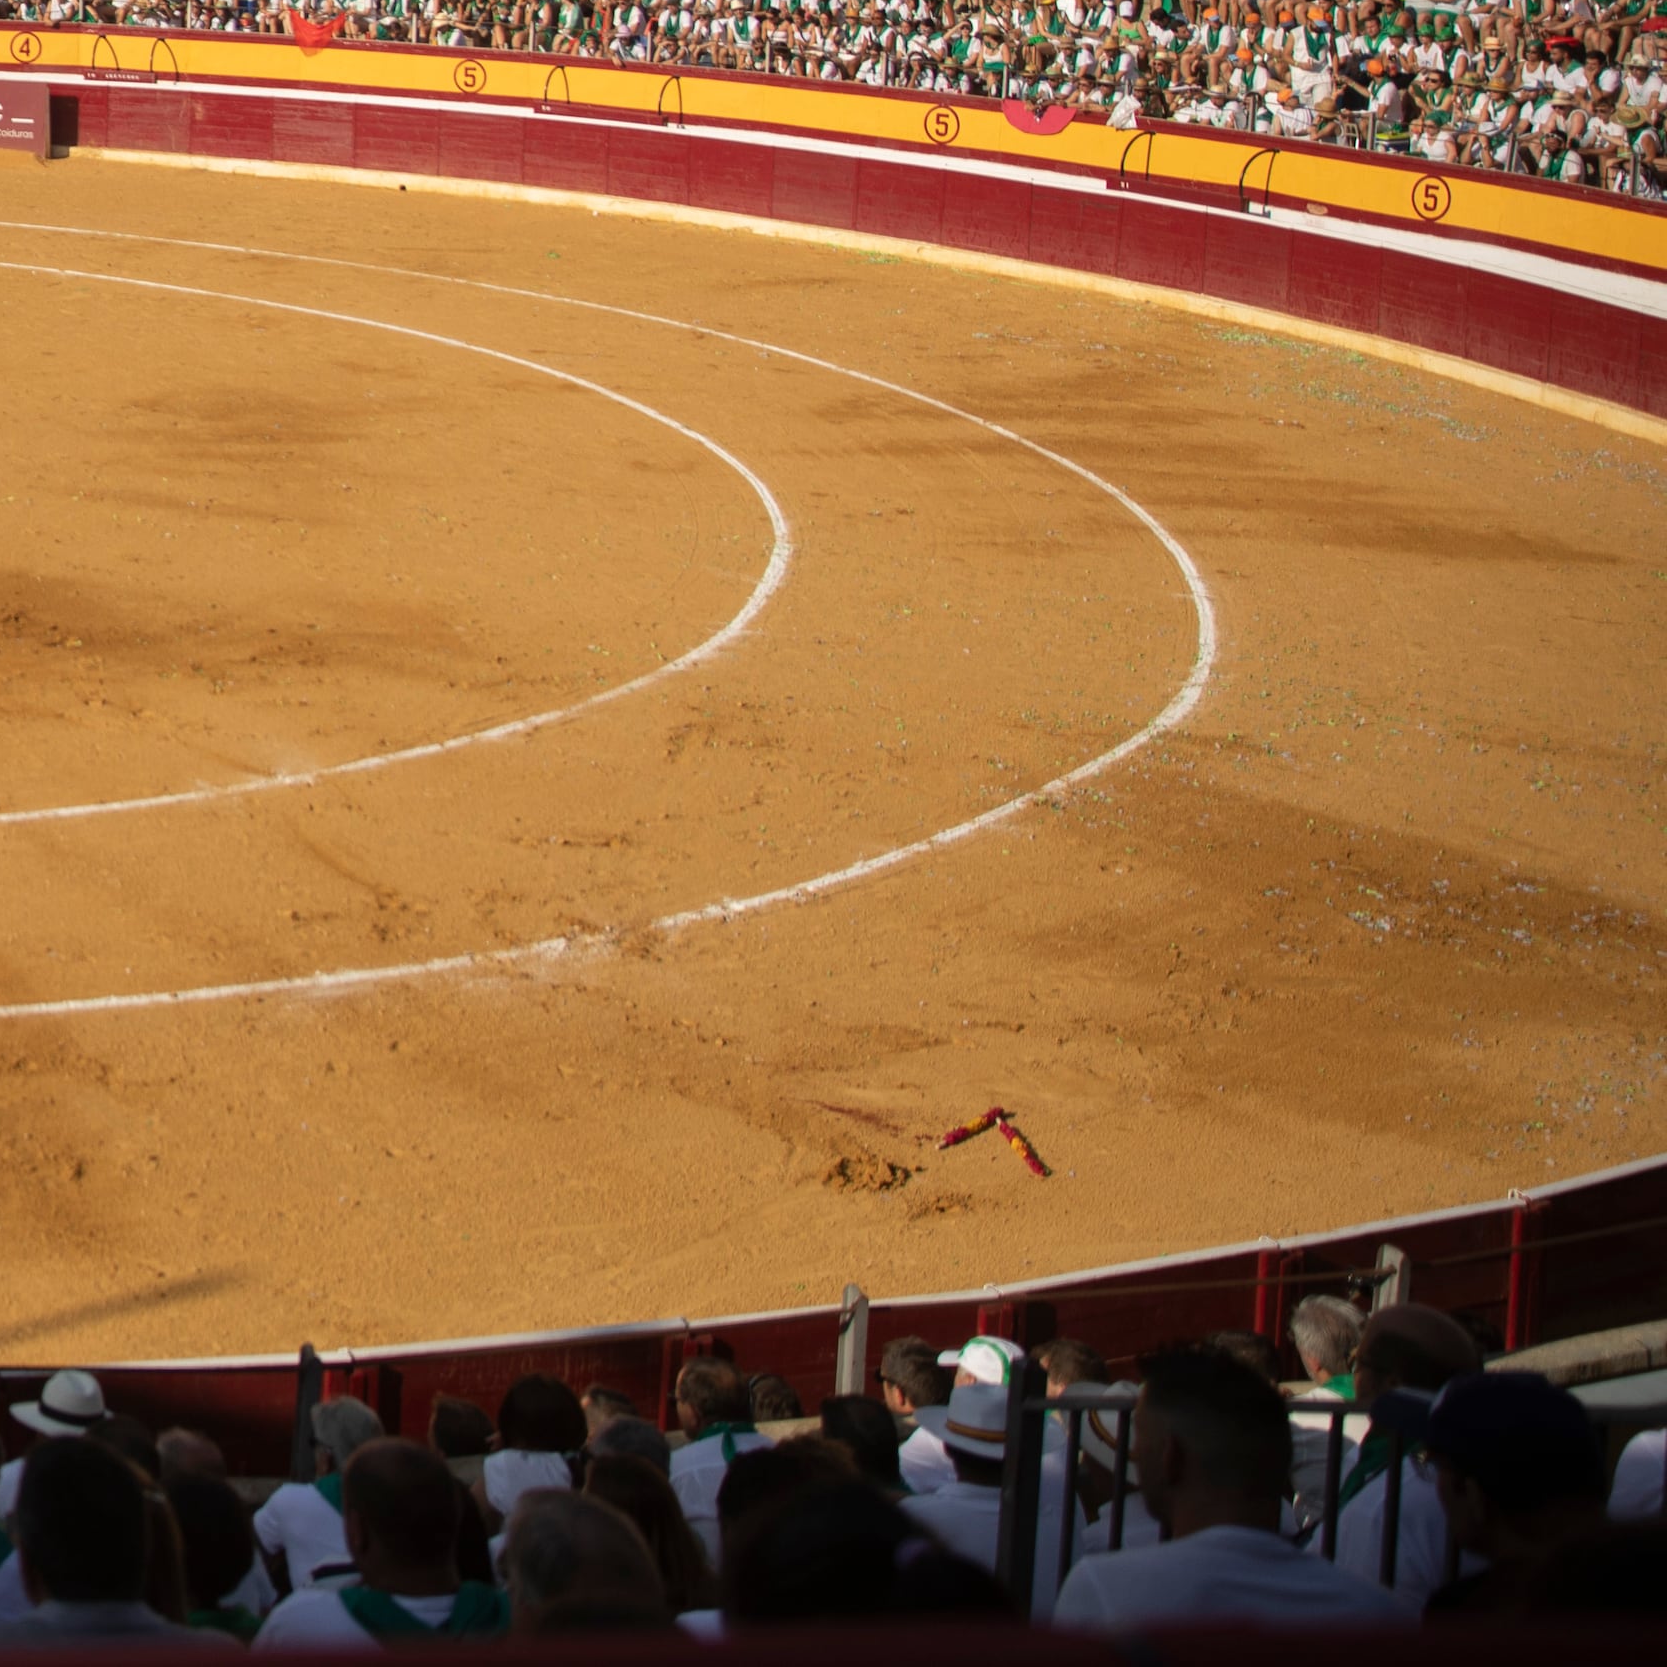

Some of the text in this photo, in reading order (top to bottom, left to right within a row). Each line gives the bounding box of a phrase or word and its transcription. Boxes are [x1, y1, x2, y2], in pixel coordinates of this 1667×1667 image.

[19, 37, 30, 57] 4
[464, 67, 476, 88] 5
[935, 112, 949, 137] 5
[1423, 184, 1440, 212] 5
